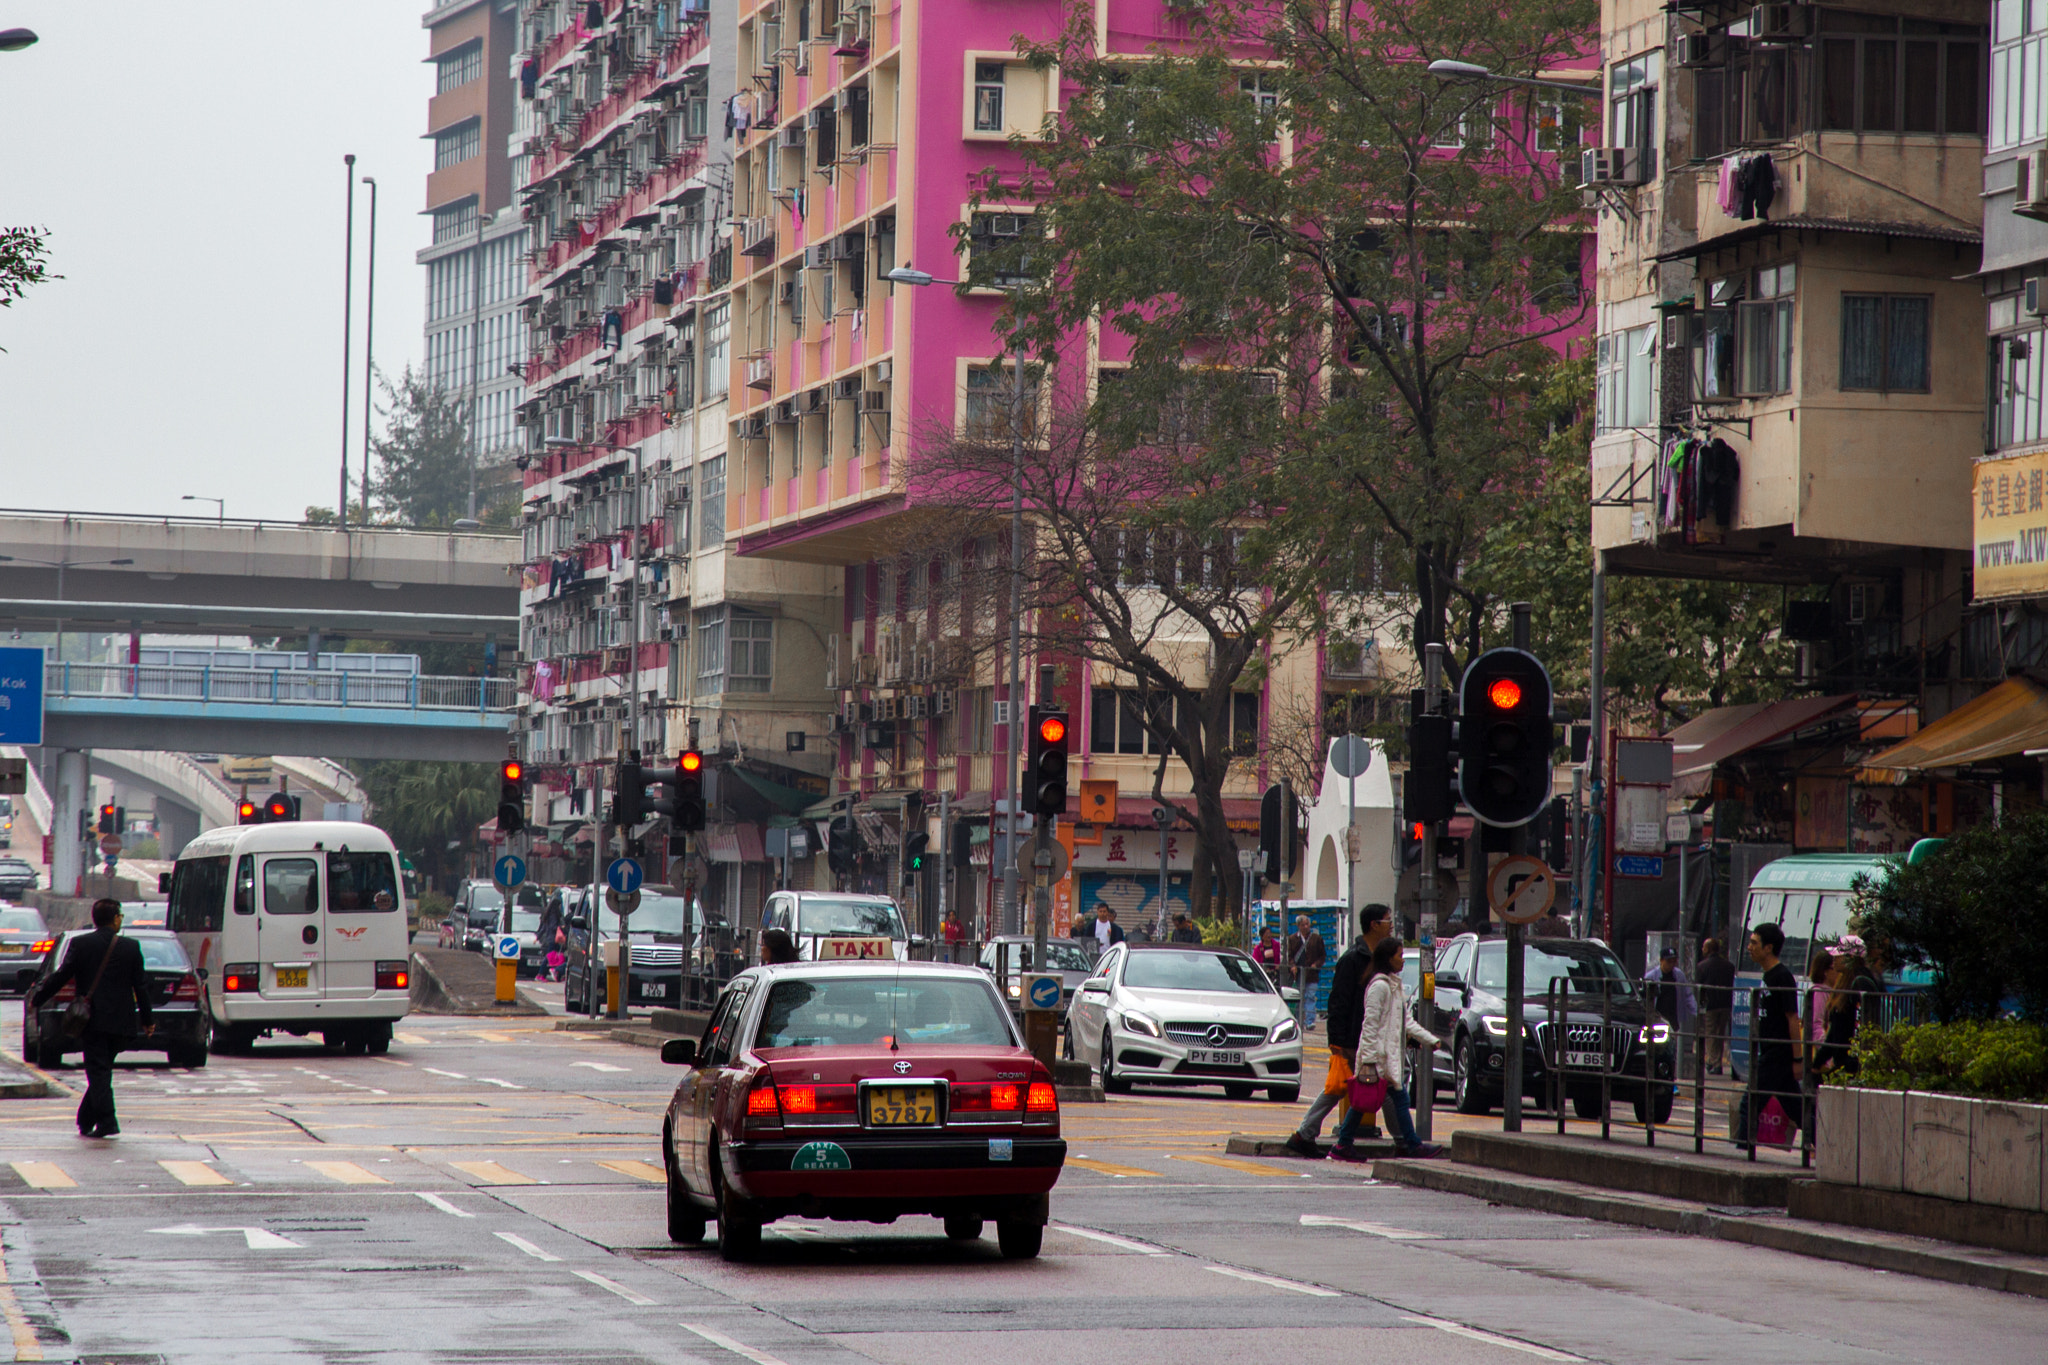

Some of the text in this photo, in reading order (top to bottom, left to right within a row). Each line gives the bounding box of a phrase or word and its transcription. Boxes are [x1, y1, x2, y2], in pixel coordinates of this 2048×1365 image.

[1980, 468, 2048, 520] 英皇金銀
[1, 677, 27, 689] Kok
[832, 941, 884, 957] TAXI
[1191, 1051, 1241, 1063] PY 5919
[887, 1089, 917, 1106] LW
[874, 1106, 933, 1123] 3787
[809, 1142, 833, 1151] TAXI
[816, 1150, 827, 1162] 5
